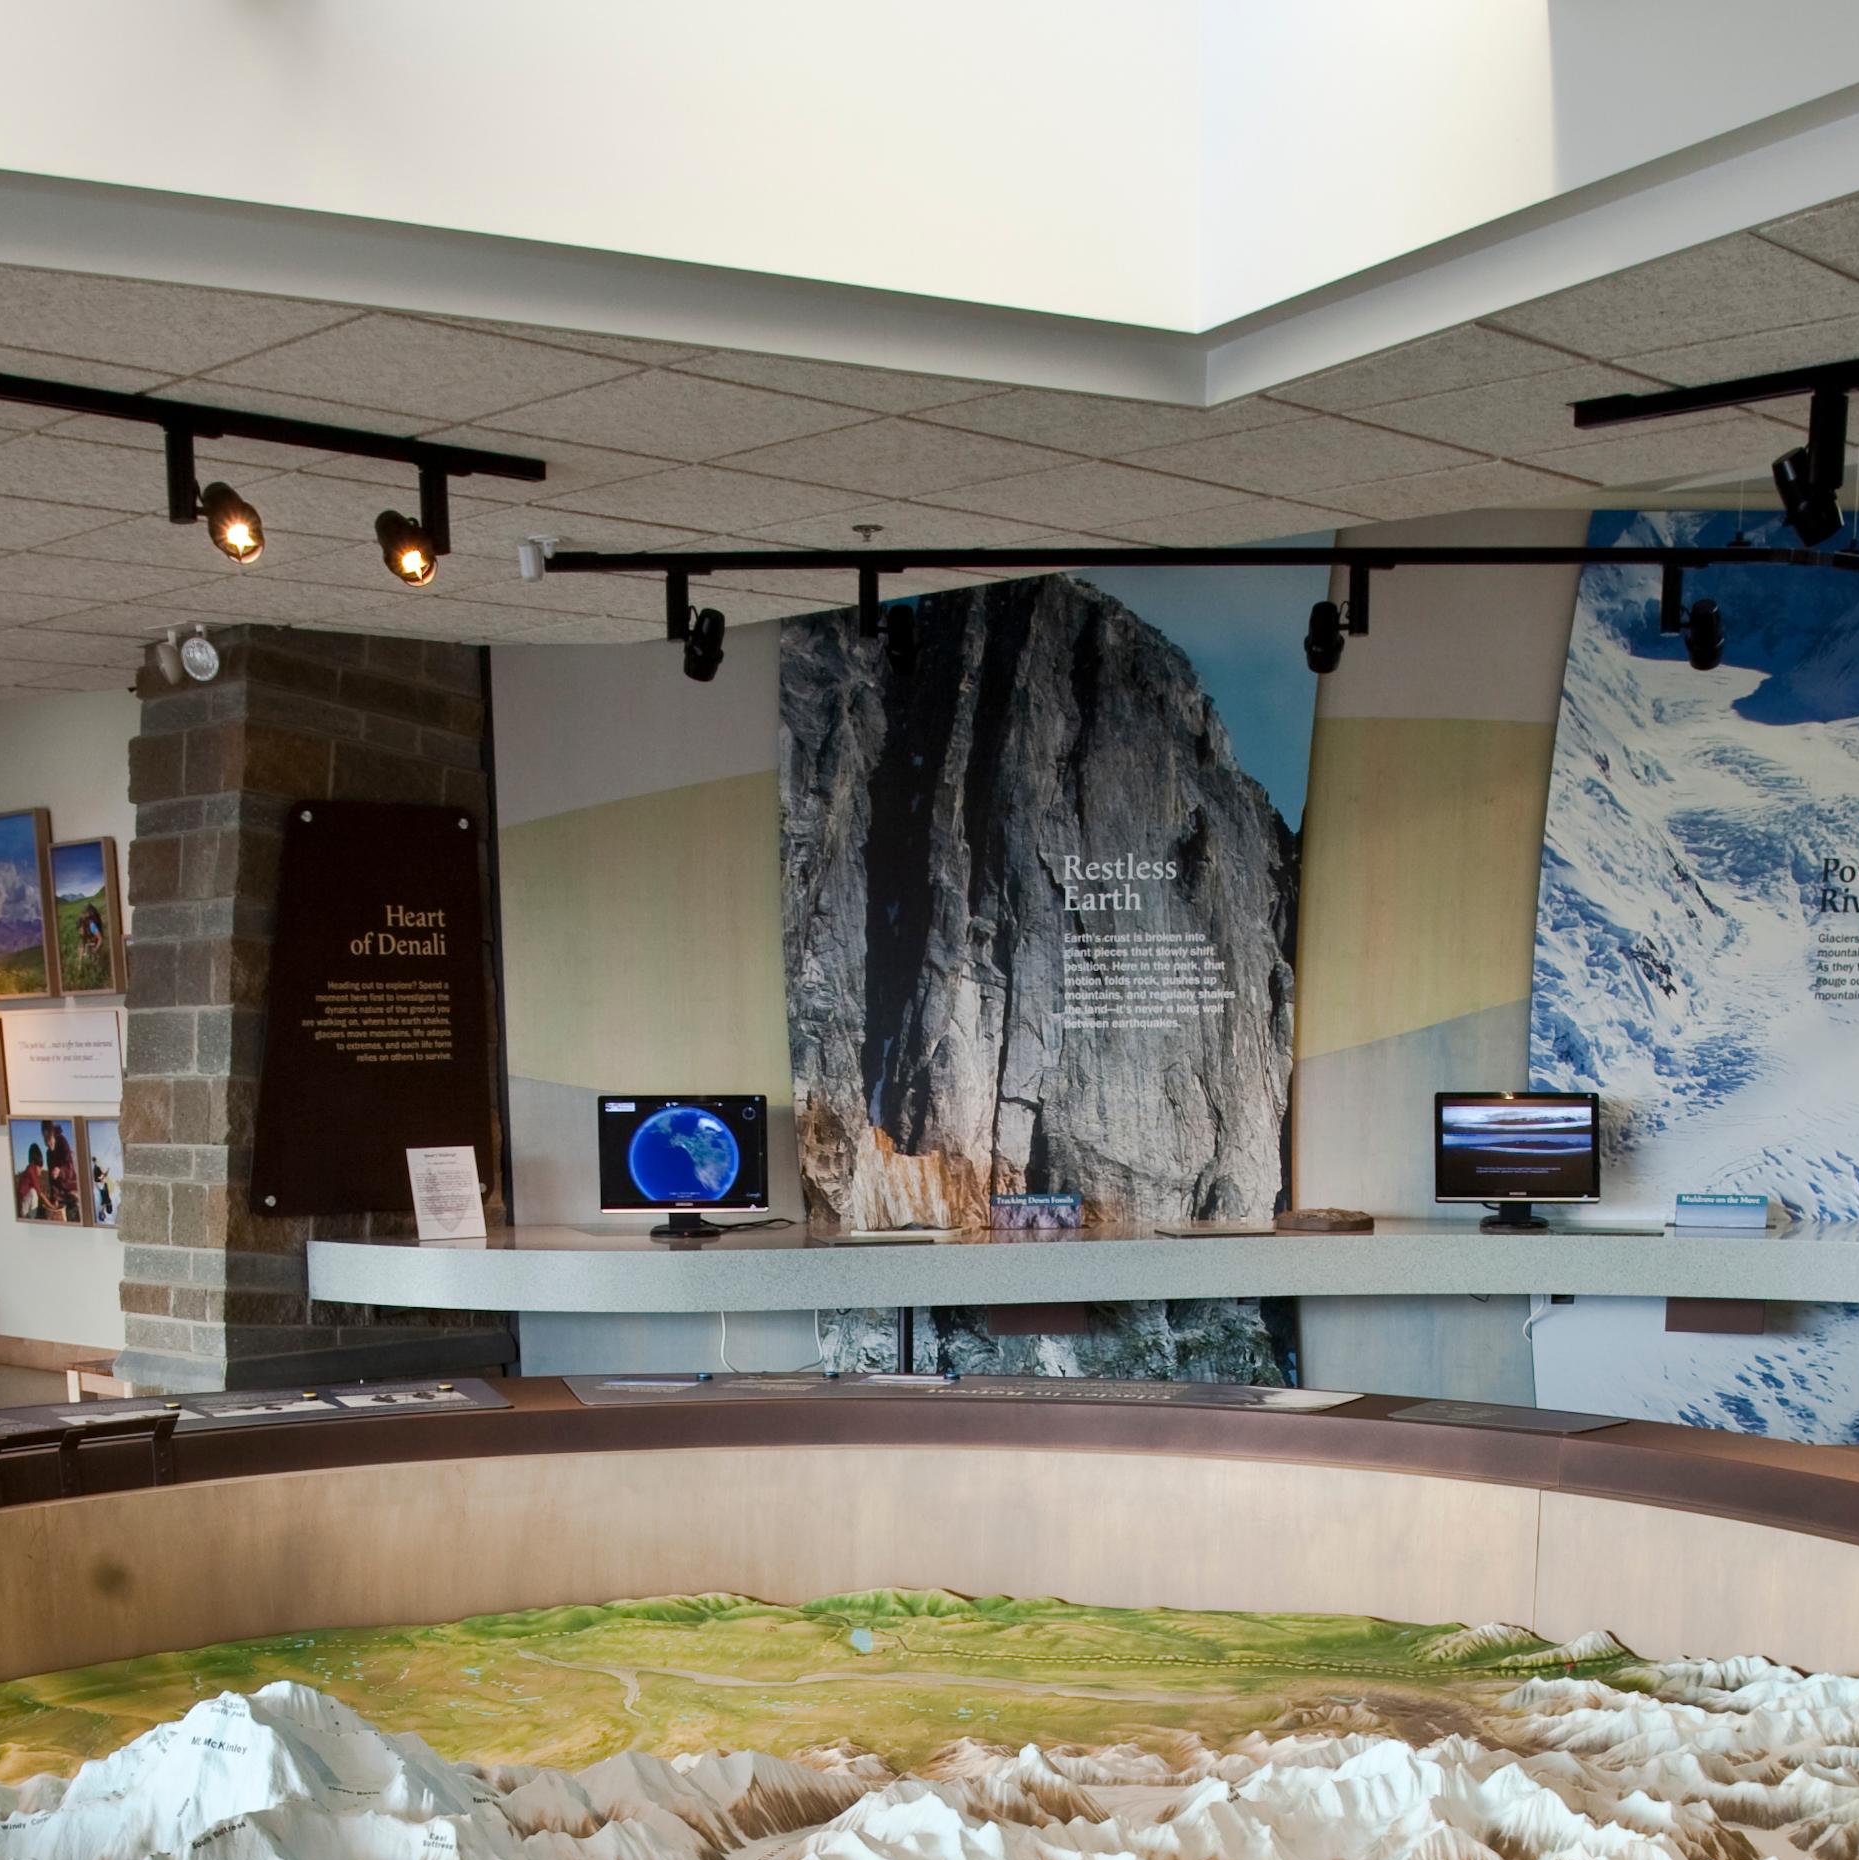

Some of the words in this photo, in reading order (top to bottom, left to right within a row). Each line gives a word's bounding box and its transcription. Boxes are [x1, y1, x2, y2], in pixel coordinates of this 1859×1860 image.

[1063, 853, 1177, 880] Restless
[1063, 885, 1141, 911] Earth
[386, 905, 446, 928] Heart
[350, 931, 373, 955] of
[378, 933, 446, 956] Denali
[1065, 933, 1101, 943] Earth's
[1104, 934, 1131, 942] crust
[1134, 934, 1142, 942] is
[1145, 933, 1182, 942] broken
[1185, 933, 1205, 942] into
[1818, 934, 1859, 944] Glaciers
[1065, 948, 1091, 959] giant
[1095, 948, 1127, 959] pieces
[1131, 948, 1153, 957] that
[1156, 947, 1187, 958] slowly
[1065, 962, 1109, 973] position.
[1112, 962, 1137, 971] Here
[1140, 962, 1150, 971] in
[1153, 961, 1171, 971] the
[1174, 961, 1200, 974] park,
[1204, 961, 1225, 971] that
[1817, 962, 1828, 972] As
[1832, 962, 1854, 975] they
[1065, 976, 1101, 986] motion
[1104, 976, 1131, 986] folds
[1163, 976, 1200, 987] pushes
[1204, 977, 1217, 987] up
[1816, 977, 1847, 988] gouge
[997, 1197, 1027, 1205] Tracking
[1740, 1196, 1760, 1204] Move
